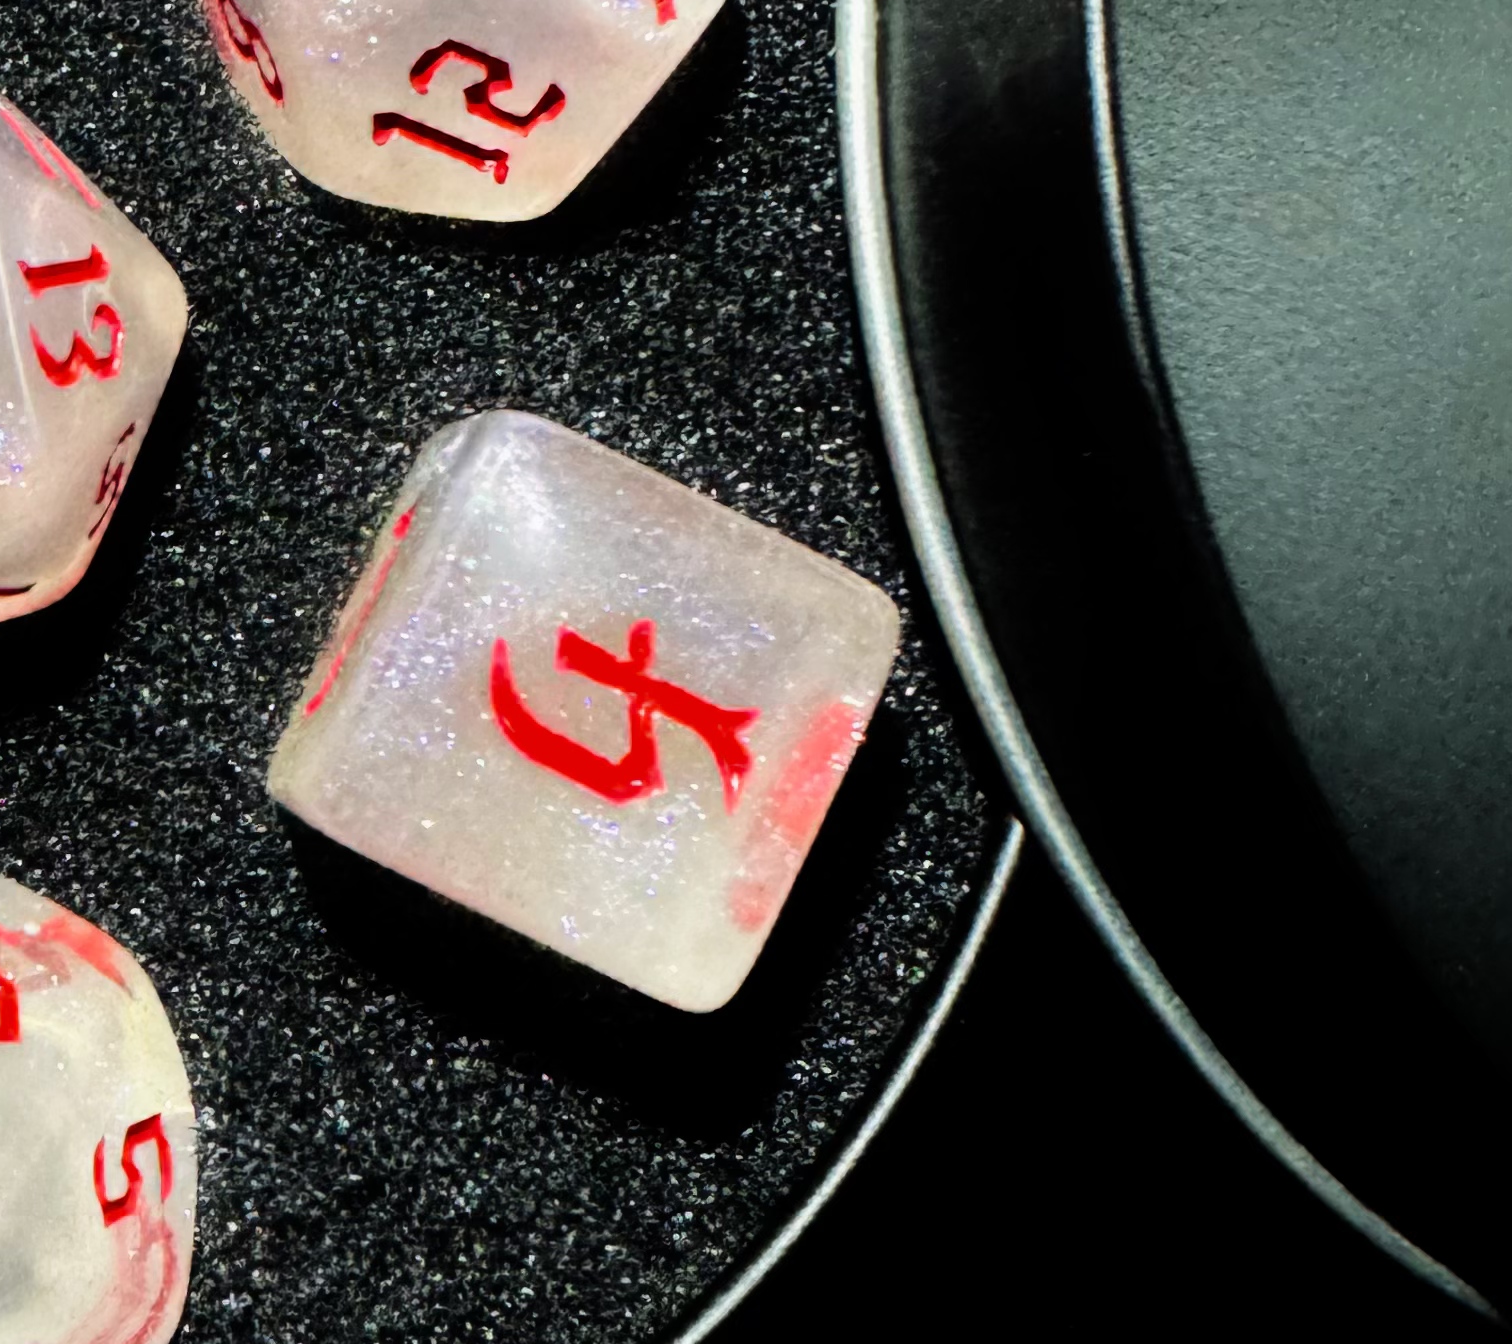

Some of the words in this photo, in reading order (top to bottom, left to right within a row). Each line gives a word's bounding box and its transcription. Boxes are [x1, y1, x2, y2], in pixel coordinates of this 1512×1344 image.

[370, 38, 568, 186] 12
[14, 242, 128, 390] 13
[488, 618, 762, 814] 4
[92, 1110, 176, 1230] 5
